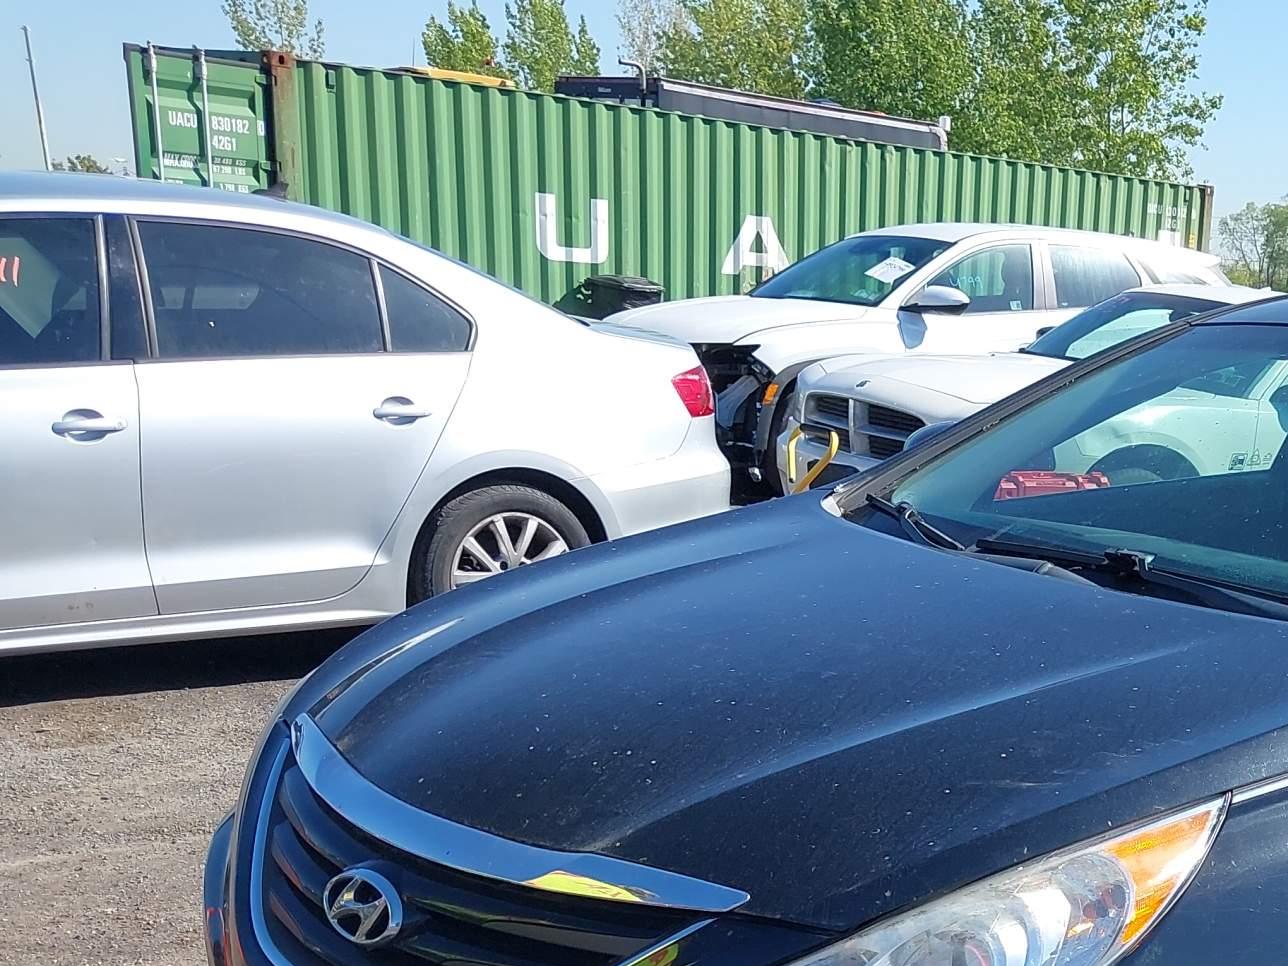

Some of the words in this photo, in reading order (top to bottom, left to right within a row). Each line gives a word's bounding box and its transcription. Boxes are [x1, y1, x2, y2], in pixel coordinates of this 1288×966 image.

[168, 110, 198, 128] UACU
[210, 115, 250, 134] 830182
[212, 135, 237, 152] 42G1
